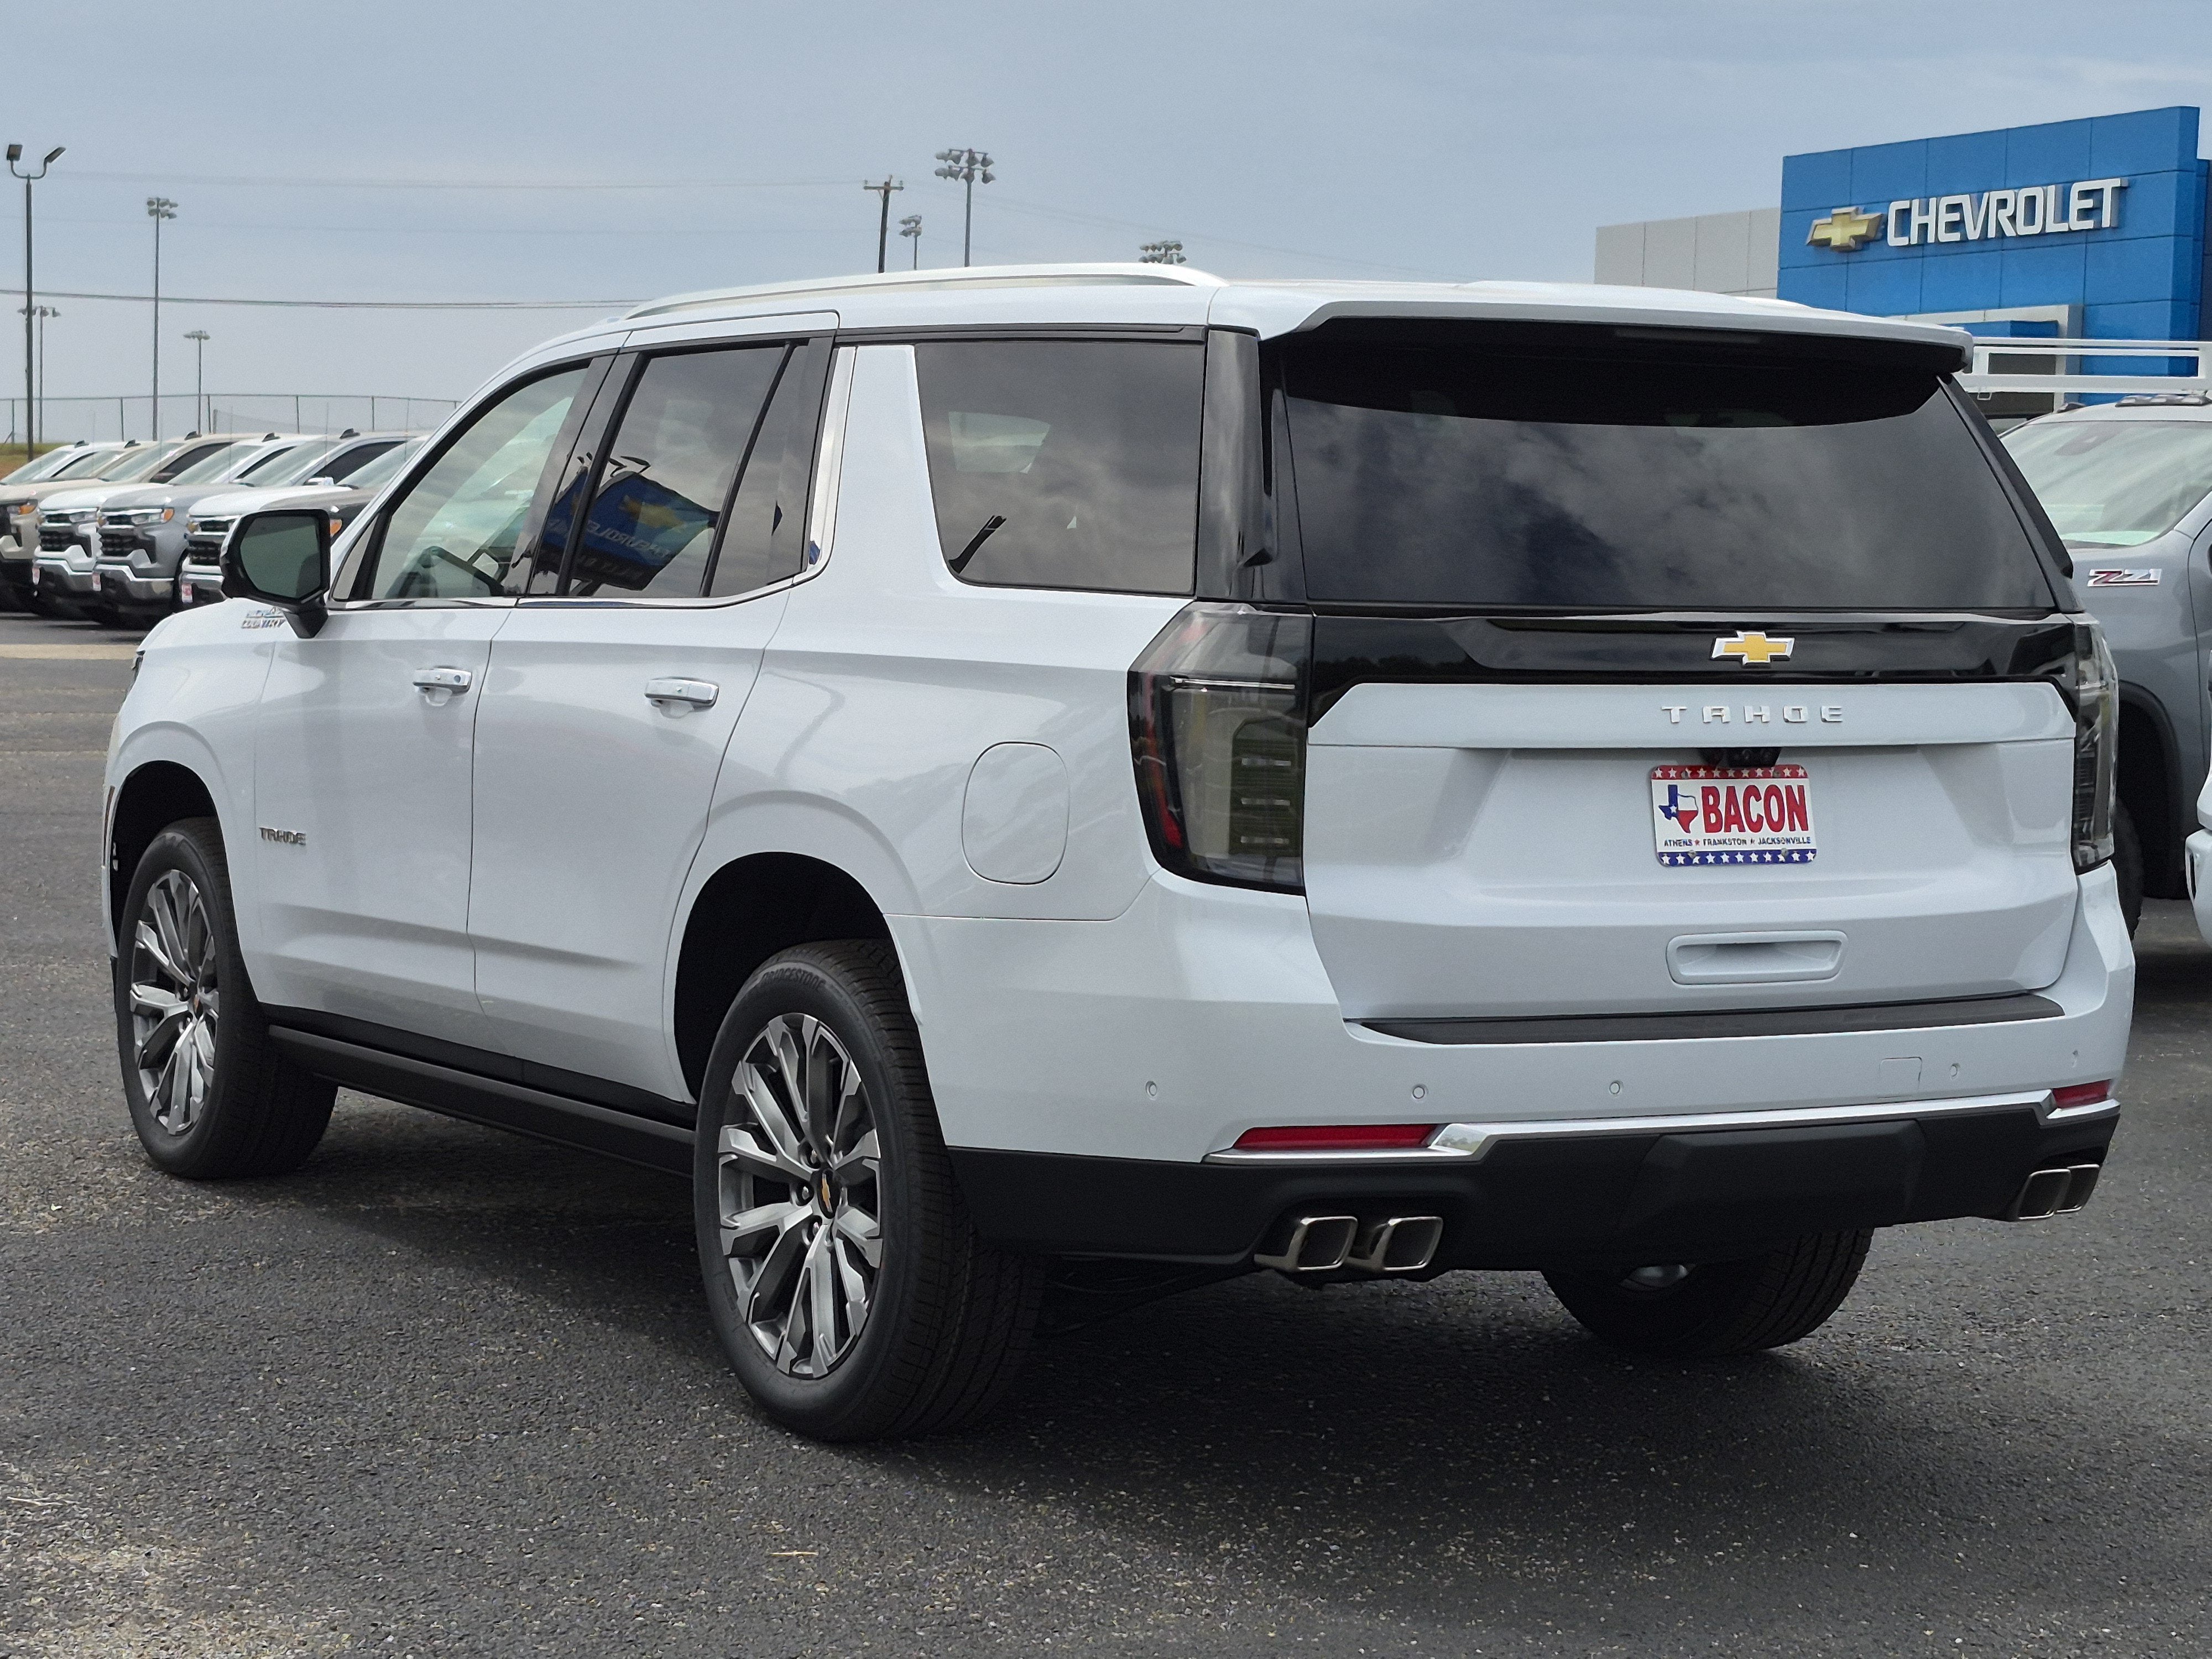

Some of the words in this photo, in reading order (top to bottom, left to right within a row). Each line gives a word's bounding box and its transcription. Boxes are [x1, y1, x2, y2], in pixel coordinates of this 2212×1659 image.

[1887, 178, 2128, 247] CHEVROLET
[1661, 705, 1843, 724] TAHOE
[1700, 784, 1809, 833] BACON
[258, 827, 306, 846] TAHOE
[1757, 836, 1811, 845] JACKSONVILLE
